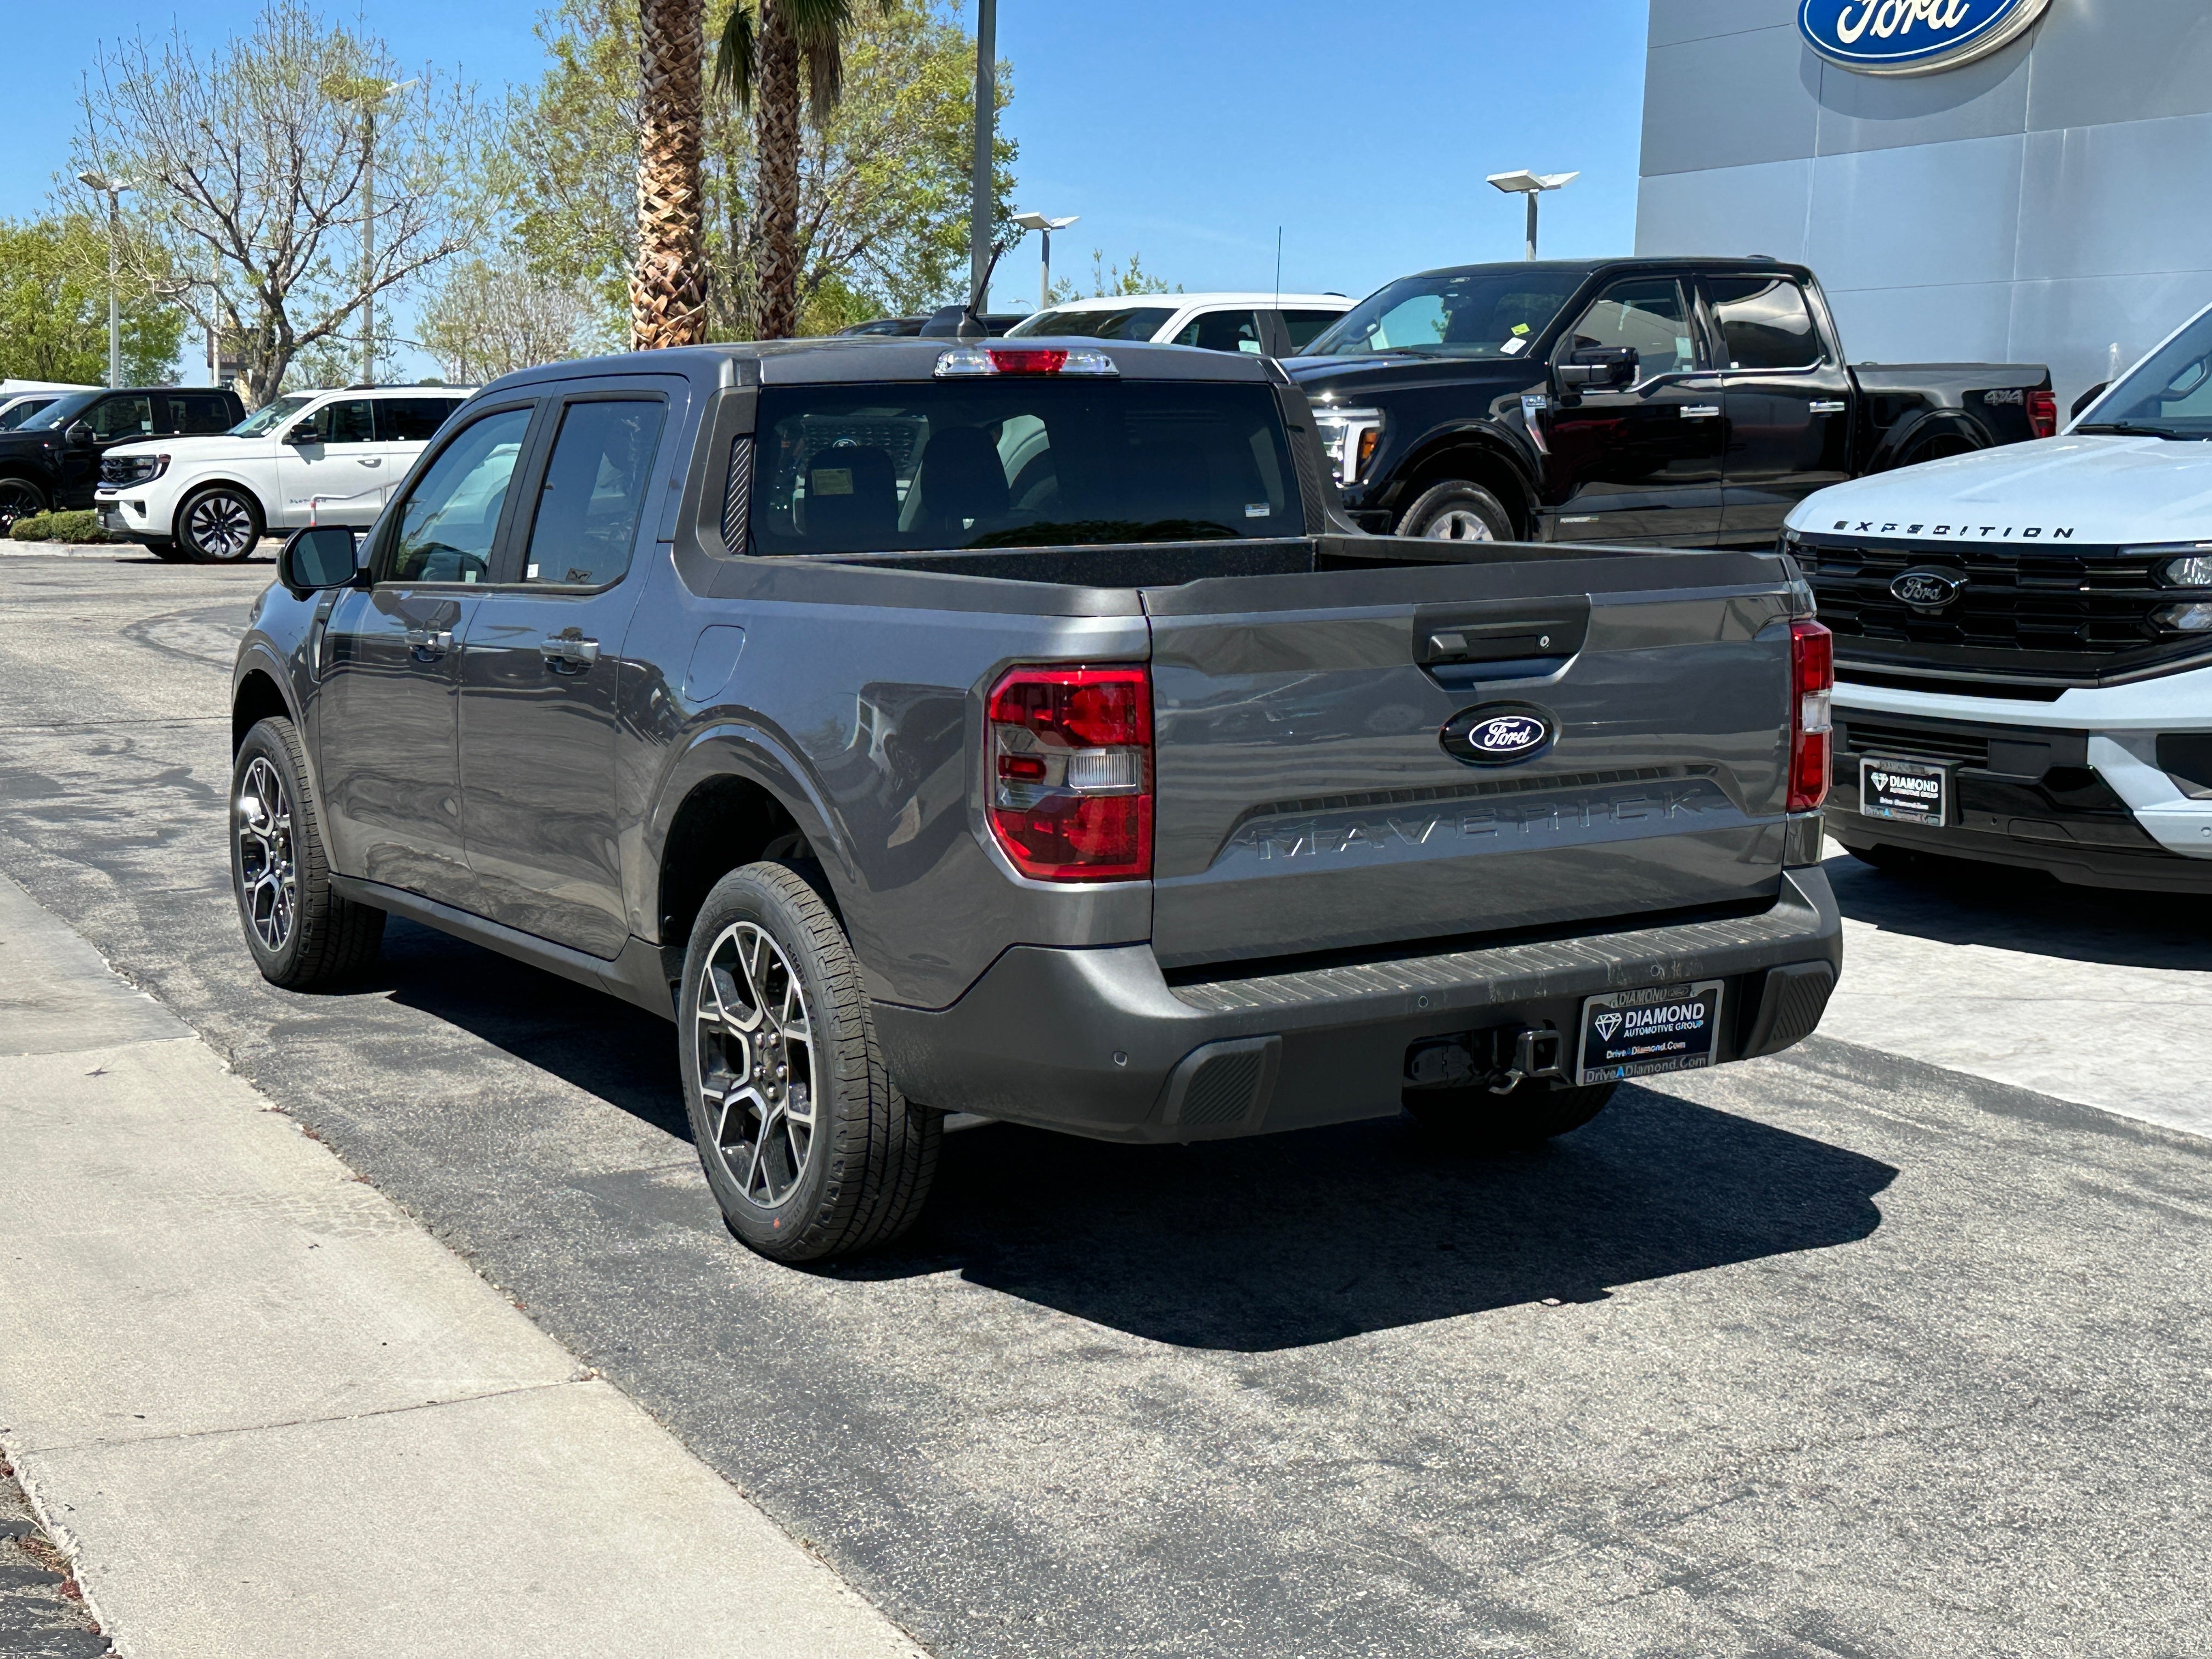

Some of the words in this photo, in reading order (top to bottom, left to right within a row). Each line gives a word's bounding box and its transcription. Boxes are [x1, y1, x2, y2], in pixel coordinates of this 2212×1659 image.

[1837, 0, 1970, 43] Ford
[1833, 520, 2074, 538] EXPEDITION
[1902, 577, 1942, 600] Ford
[1484, 721, 1530, 746] Ford
[1890, 775, 1938, 793] DIAMOND
[1255, 788, 1703, 860] MAVERICK
[1619, 988, 1667, 1006] DIAMOND
[1625, 1003, 1705, 1028] DIAMOND
[1623, 1024, 1673, 1039] AUTOMOTIVE
[1675, 1020, 1704, 1031] GROUP
